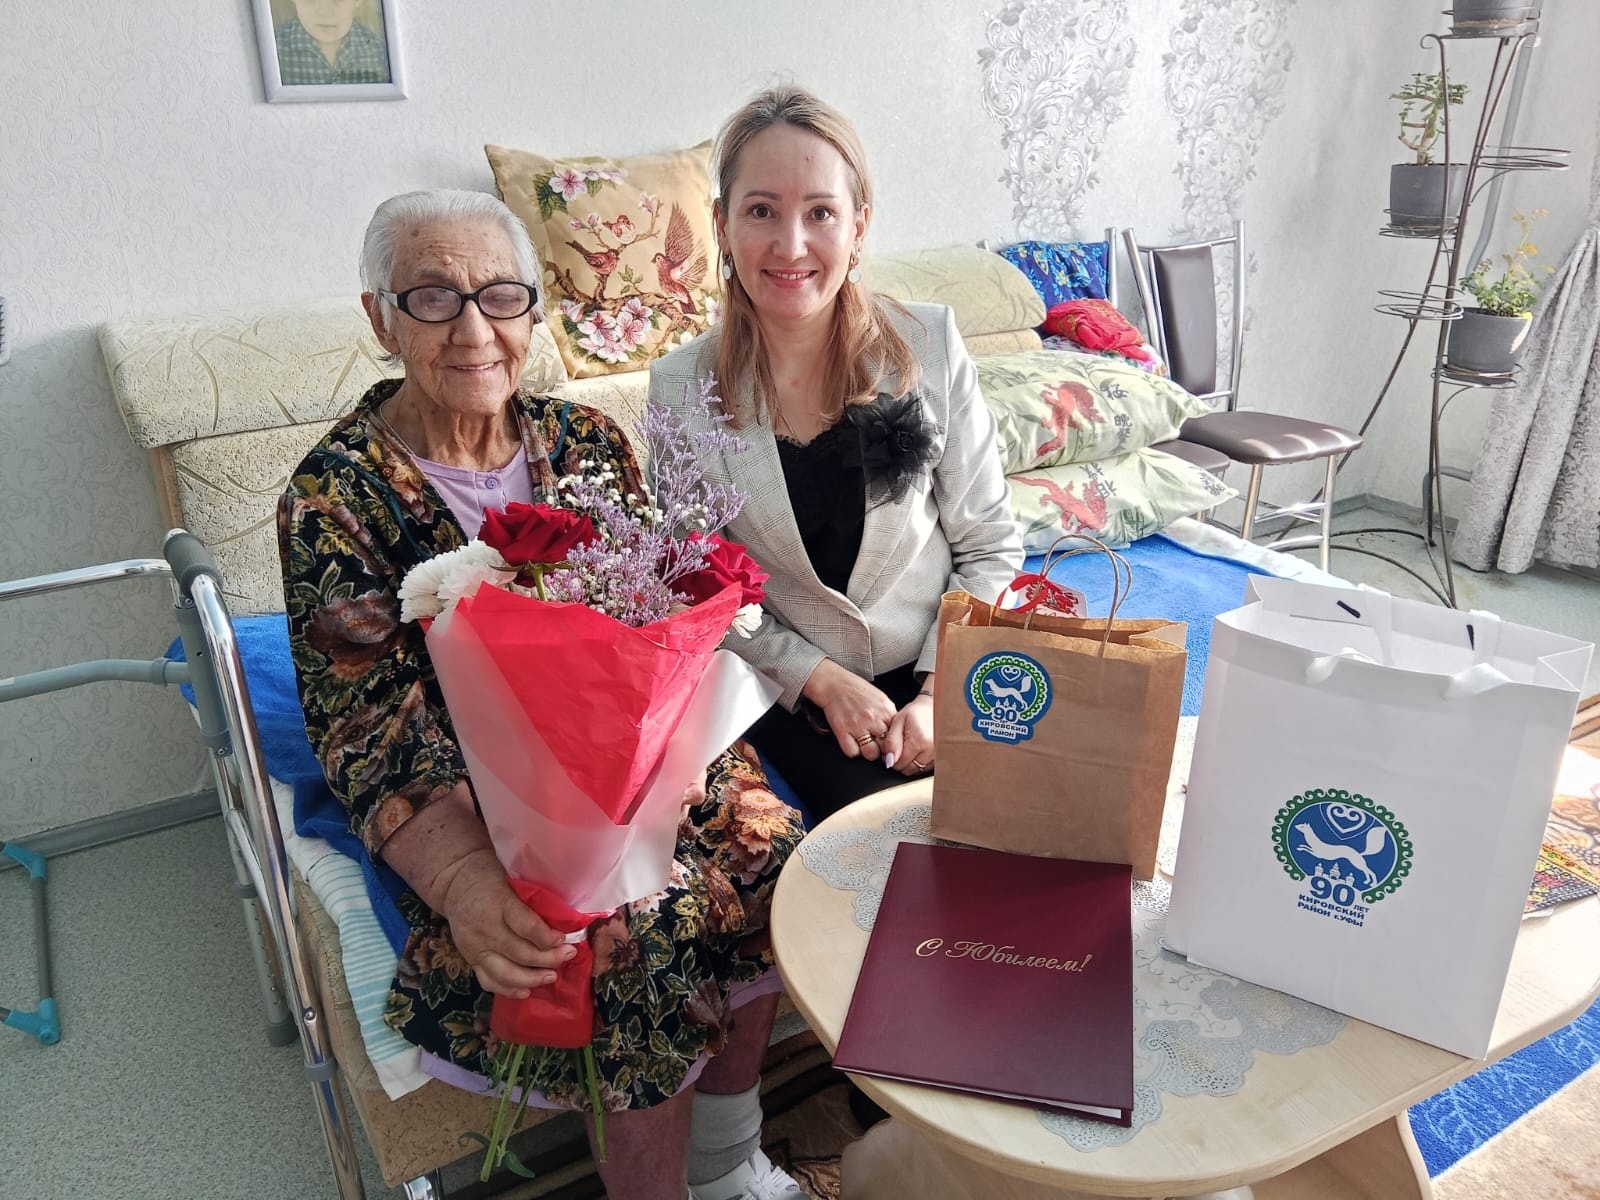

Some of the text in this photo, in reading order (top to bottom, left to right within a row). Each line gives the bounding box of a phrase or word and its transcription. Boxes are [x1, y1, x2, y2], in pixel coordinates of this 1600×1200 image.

[993, 707, 1017, 722] 90
[979, 720, 1027, 733] КИРОВСКИЙ
[990, 729, 1015, 738] РАЙОН
[1309, 876, 1356, 907] 90
[1297, 901, 1331, 917] РАЙОН
[1298, 894, 1365, 920] КИРОВСКИЙ
[915, 937, 1093, 972] С Юбилеем!
